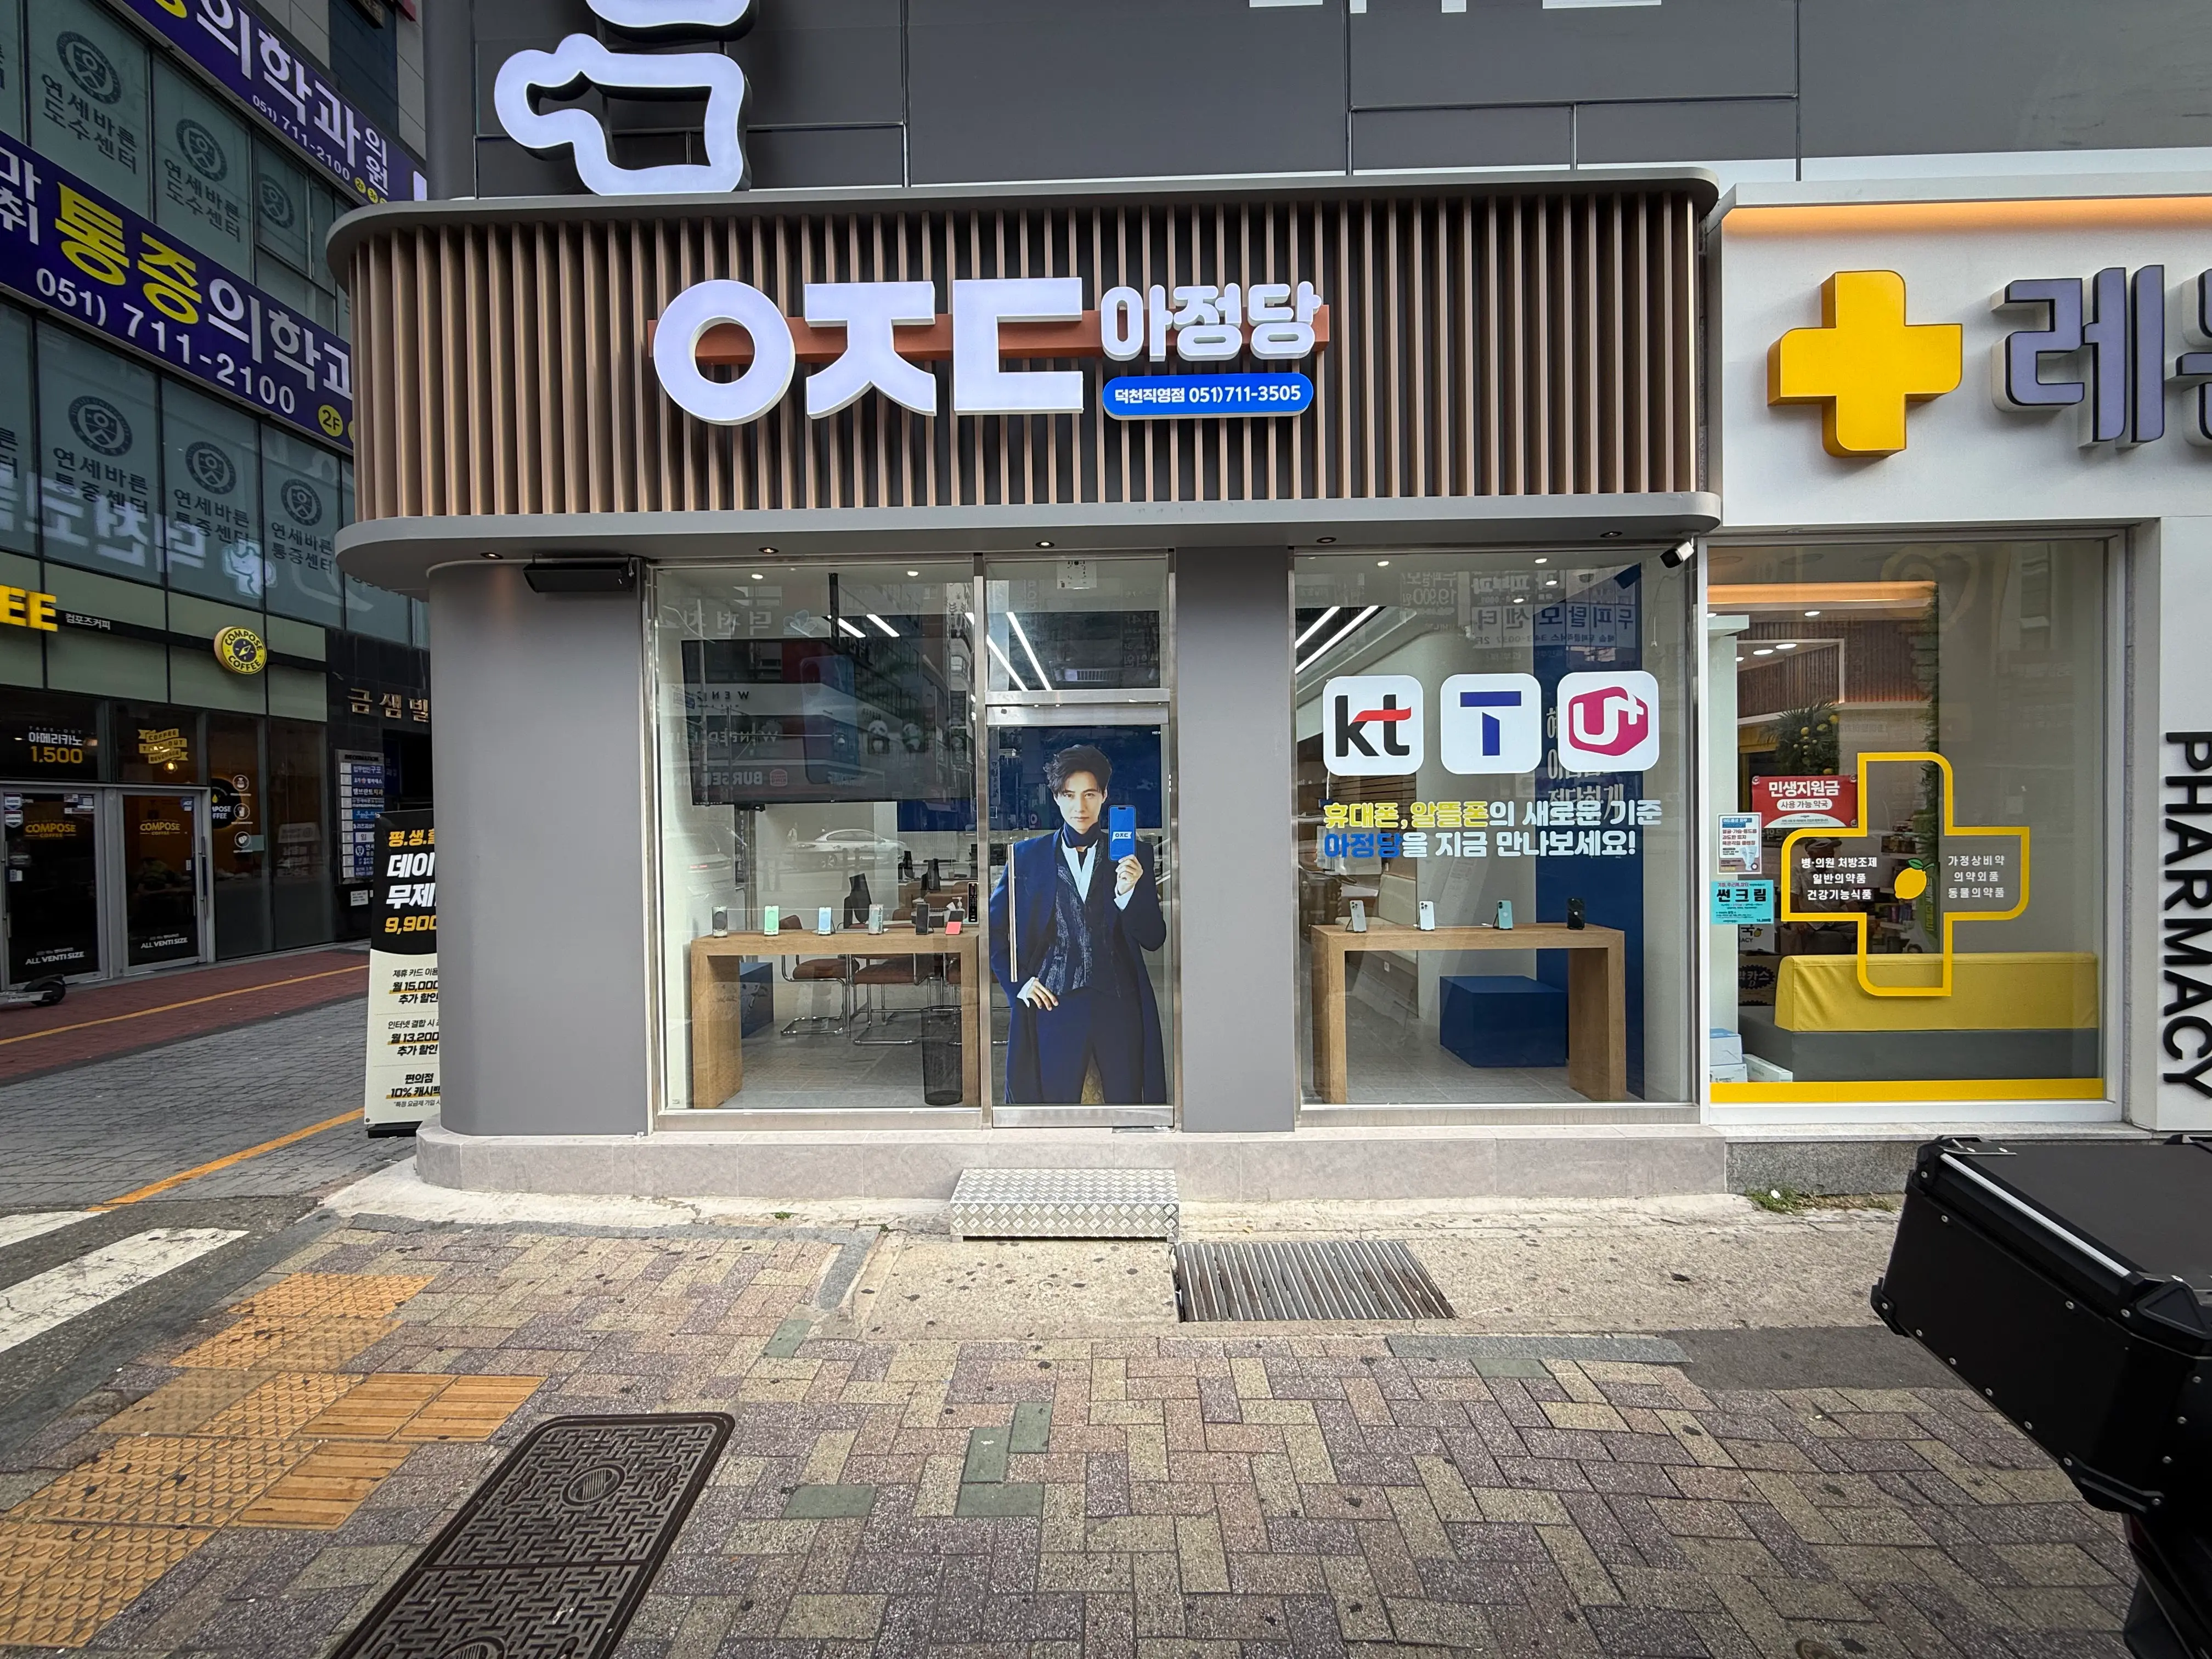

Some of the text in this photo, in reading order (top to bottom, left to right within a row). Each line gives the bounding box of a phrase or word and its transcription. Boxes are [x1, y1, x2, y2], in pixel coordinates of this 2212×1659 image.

[42, 74, 137, 153] 연세바른
[43, 97, 137, 174] 도수센터
[252, 94, 351, 182] 051) 711-2100
[165, 158, 241, 224] 연세바른
[165, 181, 241, 244] 도수센터
[1101, 281, 1323, 362] 아정당
[36, 268, 295, 415] 051) 711-2100
[1997, 263, 2212, 445] 레
[1115, 387, 1185, 404] 덕천직영점
[322, 409, 340, 431] 2F
[53, 447, 149, 496] 연세바른
[173, 488, 250, 528] 연세바른
[271, 522, 333, 556] 연세바른
[272, 542, 333, 574] 통증센터
[65, 613, 111, 630] 컴포즈커피
[225, 630, 264, 651] COMPOSE
[228, 655, 261, 671] COFFEE
[1334, 693, 1412, 758] kt
[1459, 690, 1522, 757] T
[28, 732, 83, 746] 아메리카노
[30, 746, 83, 764] 1.500
[1768, 780, 1841, 798] 민생지원금
[1797, 800, 1812, 808] 가능
[1813, 799, 1829, 808] 약국
[1522, 800, 1601, 827] 새로운
[1610, 799, 1663, 826] 기준
[25, 823, 76, 833] COMPOSE
[140, 822, 180, 831] COMPOSE
[1324, 829, 1637, 859] 아정당을 지금 만나보세요!
[1801, 856, 1877, 869] 병·의원 처방조제
[1948, 854, 2005, 867] 가정상비약
[1812, 873, 1866, 885] 일반의약품
[1953, 870, 2000, 883] 의약외품
[1807, 889, 1872, 901] 건강기능식품
[1948, 886, 2005, 899] 동물의약품
[2163, 731, 2212, 1099] PHARMACY
[41, 953, 66, 962] VENTI
[392, 970, 408, 978] 제휴
[409, 968, 424, 977] 카드
[398, 992, 439, 1005] 추가 할인
[388, 1020, 410, 1030] 인터넷
[411, 1020, 427, 1029] 결합
[397, 1045, 438, 1057] 추가 할인
[404, 1073, 435, 1085] 편의점
[390, 1088, 411, 1098] 10%
